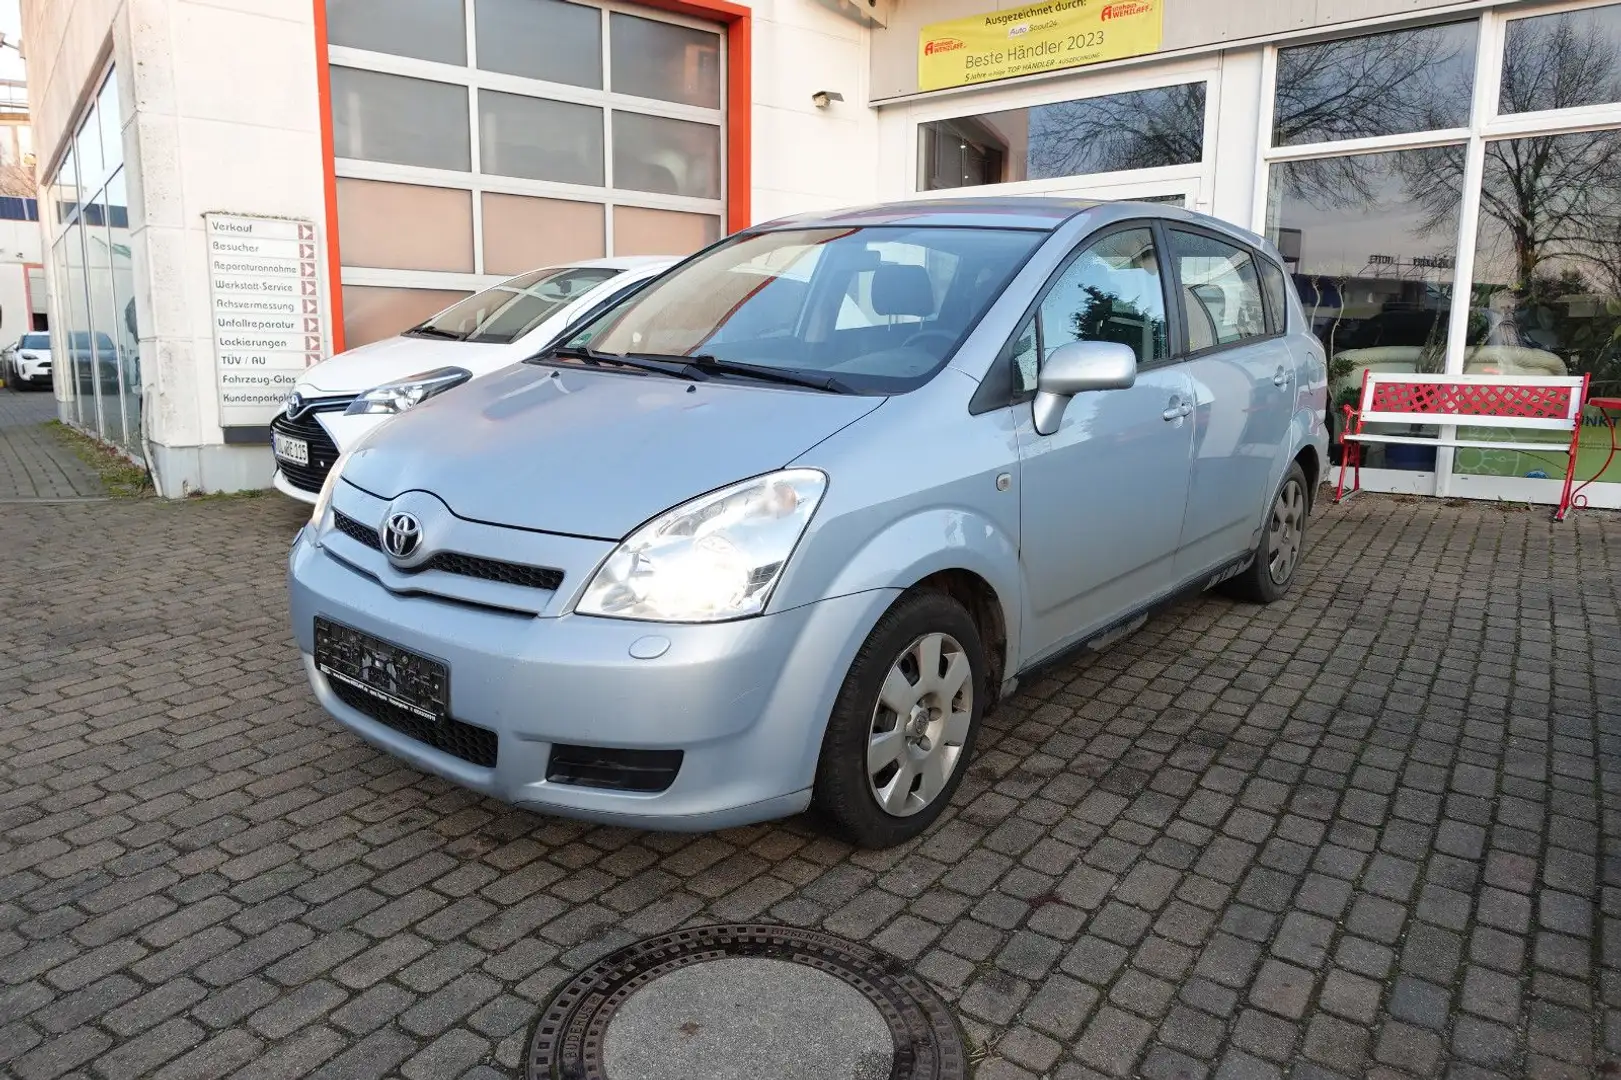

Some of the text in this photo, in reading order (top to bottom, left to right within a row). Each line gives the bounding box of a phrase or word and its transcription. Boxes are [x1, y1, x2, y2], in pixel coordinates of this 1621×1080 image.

[985, 0, 1087, 26] Ausgezeichnet durch:
[965, 30, 1105, 69] Beste Händler 2023
[212, 221, 252, 232] Verkauf
[212, 241, 259, 252] Besucher
[214, 260, 297, 273] Reparaturannahme
[216, 299, 294, 312] Achsvermessung
[218, 318, 294, 330] Unfallreparatur
[220, 338, 287, 348] Lackierungen
[221, 353, 241, 365] TÜV
[251, 356, 266, 365] AU
[222, 374, 296, 385] Fahrzeug-Glas
